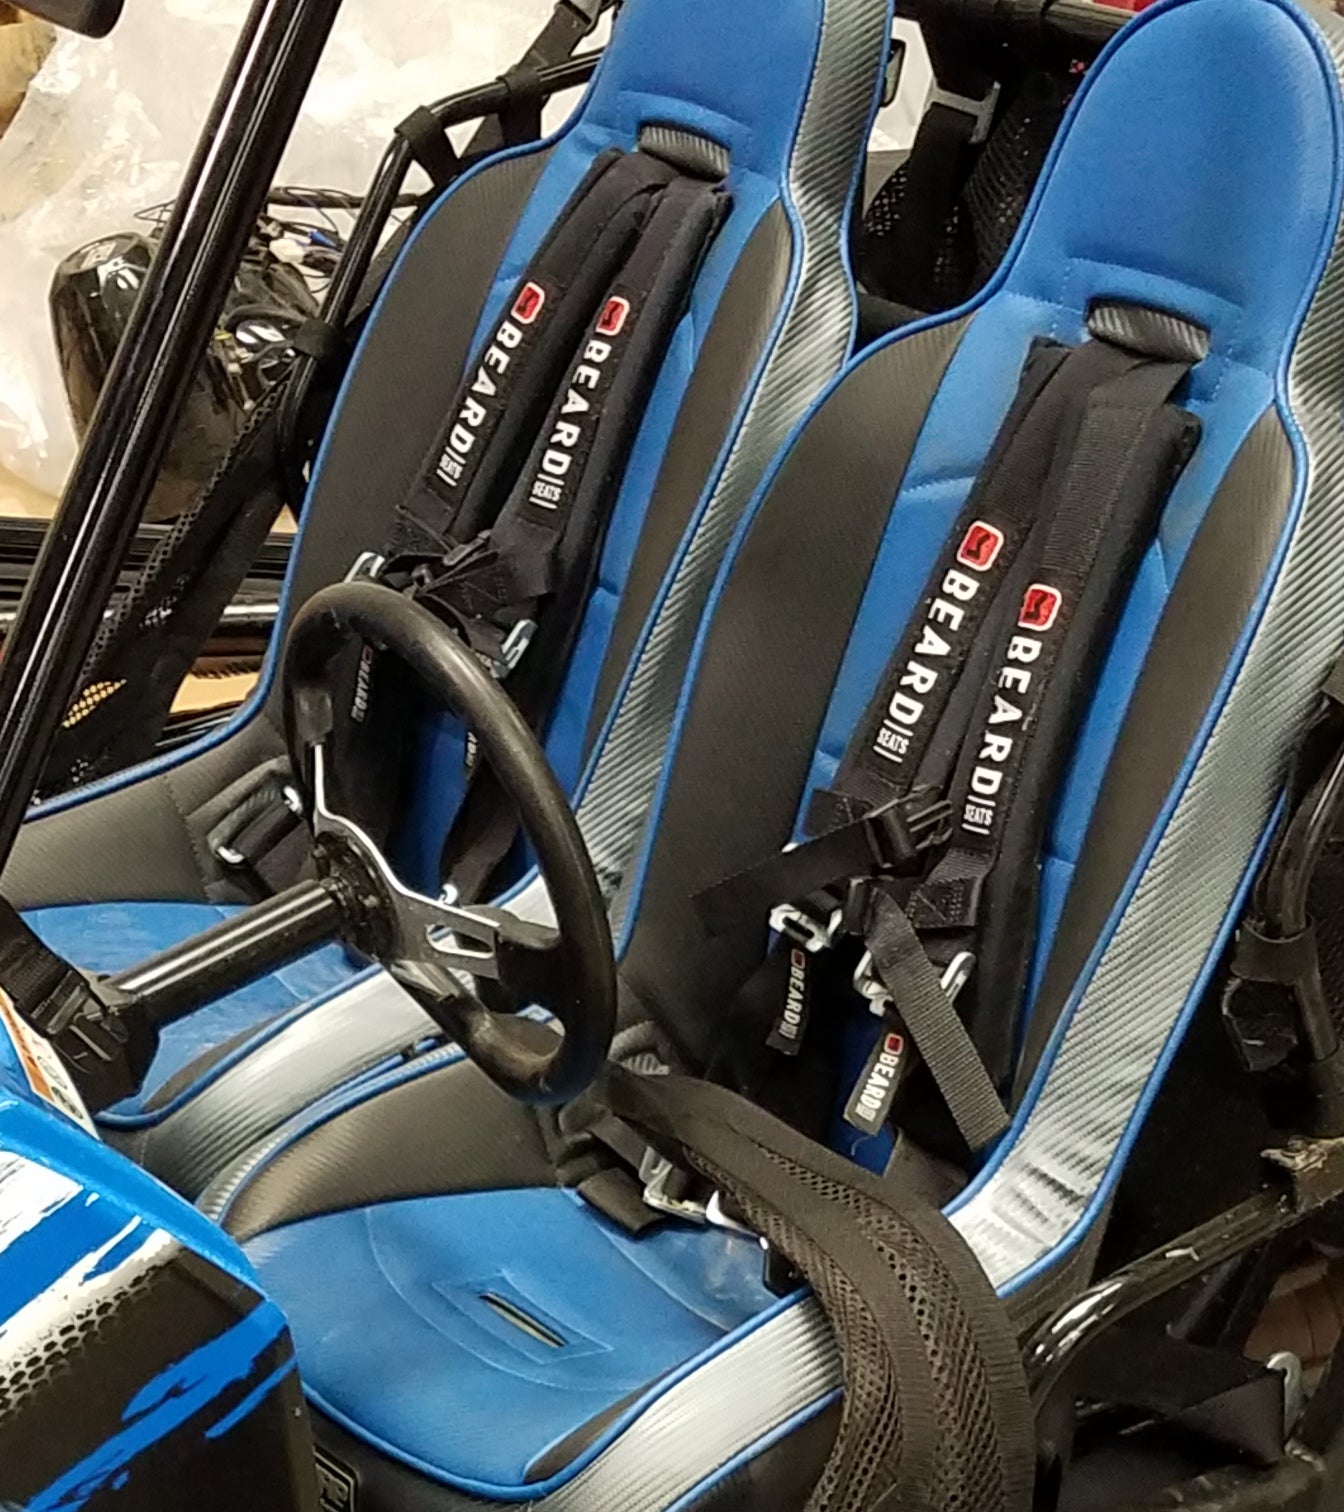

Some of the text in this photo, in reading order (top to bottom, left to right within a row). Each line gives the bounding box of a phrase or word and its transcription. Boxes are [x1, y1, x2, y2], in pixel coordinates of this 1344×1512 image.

[438, 320, 523, 480] BEARD SEATS
[532, 339, 612, 502] BEARD SEATS
[877, 568, 980, 756] BEARD SEATS
[963, 635, 1043, 827] BEARD SEATS
[783, 966, 805, 1025] BEARD
[859, 1052, 900, 1110] BEARD
